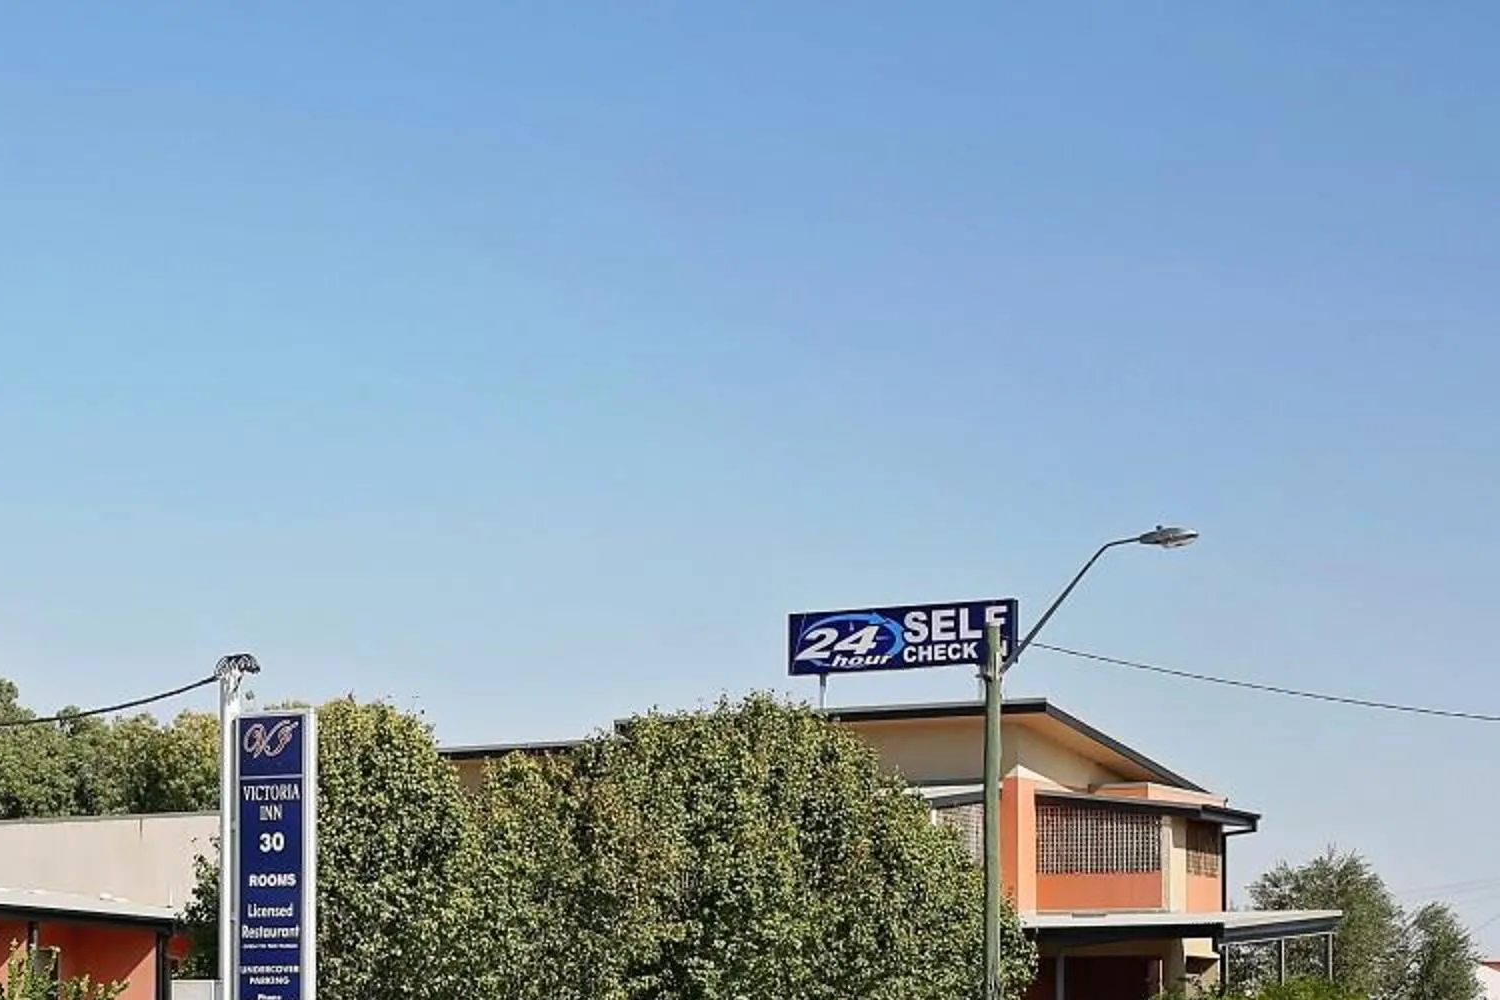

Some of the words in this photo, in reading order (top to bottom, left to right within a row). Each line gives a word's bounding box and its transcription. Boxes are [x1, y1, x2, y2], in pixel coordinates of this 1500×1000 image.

[795, 625, 880, 661] 24
[832, 653, 893, 668] hour
[903, 642, 979, 663] CHECK
[243, 784, 300, 801] VICTORIA
[260, 804, 282, 820] INN
[260, 832, 285, 852] 30
[249, 873, 297, 887] ROOMS
[247, 902, 293, 917] Licensed
[242, 924, 299, 938] Restaurant
